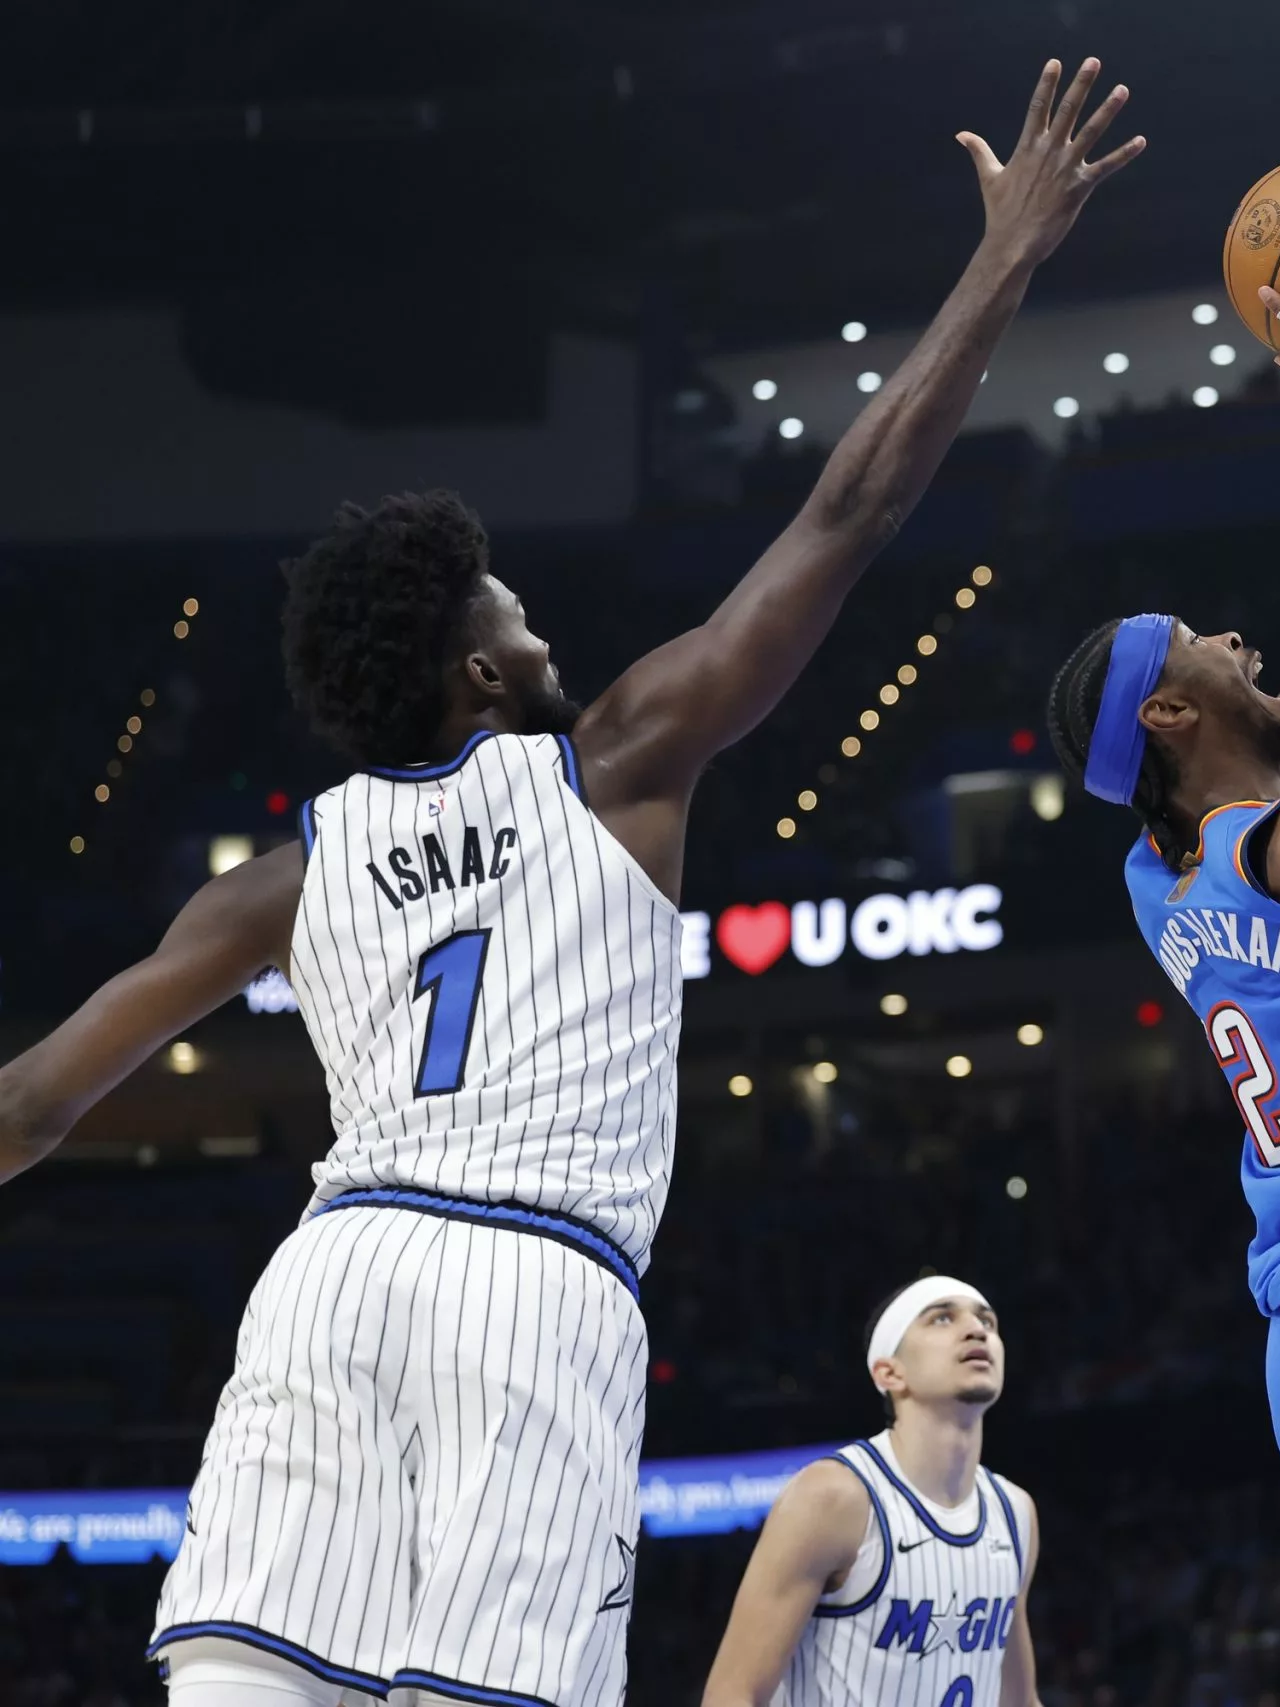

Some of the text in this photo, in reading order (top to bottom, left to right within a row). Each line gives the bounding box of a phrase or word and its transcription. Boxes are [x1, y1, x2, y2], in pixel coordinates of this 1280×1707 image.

[366, 826, 516, 910] ISAAC
[791, 897, 847, 967] U
[850, 884, 1003, 961] OKC
[412, 928, 492, 1099] 1
[874, 1593, 1016, 1655] MGIC
